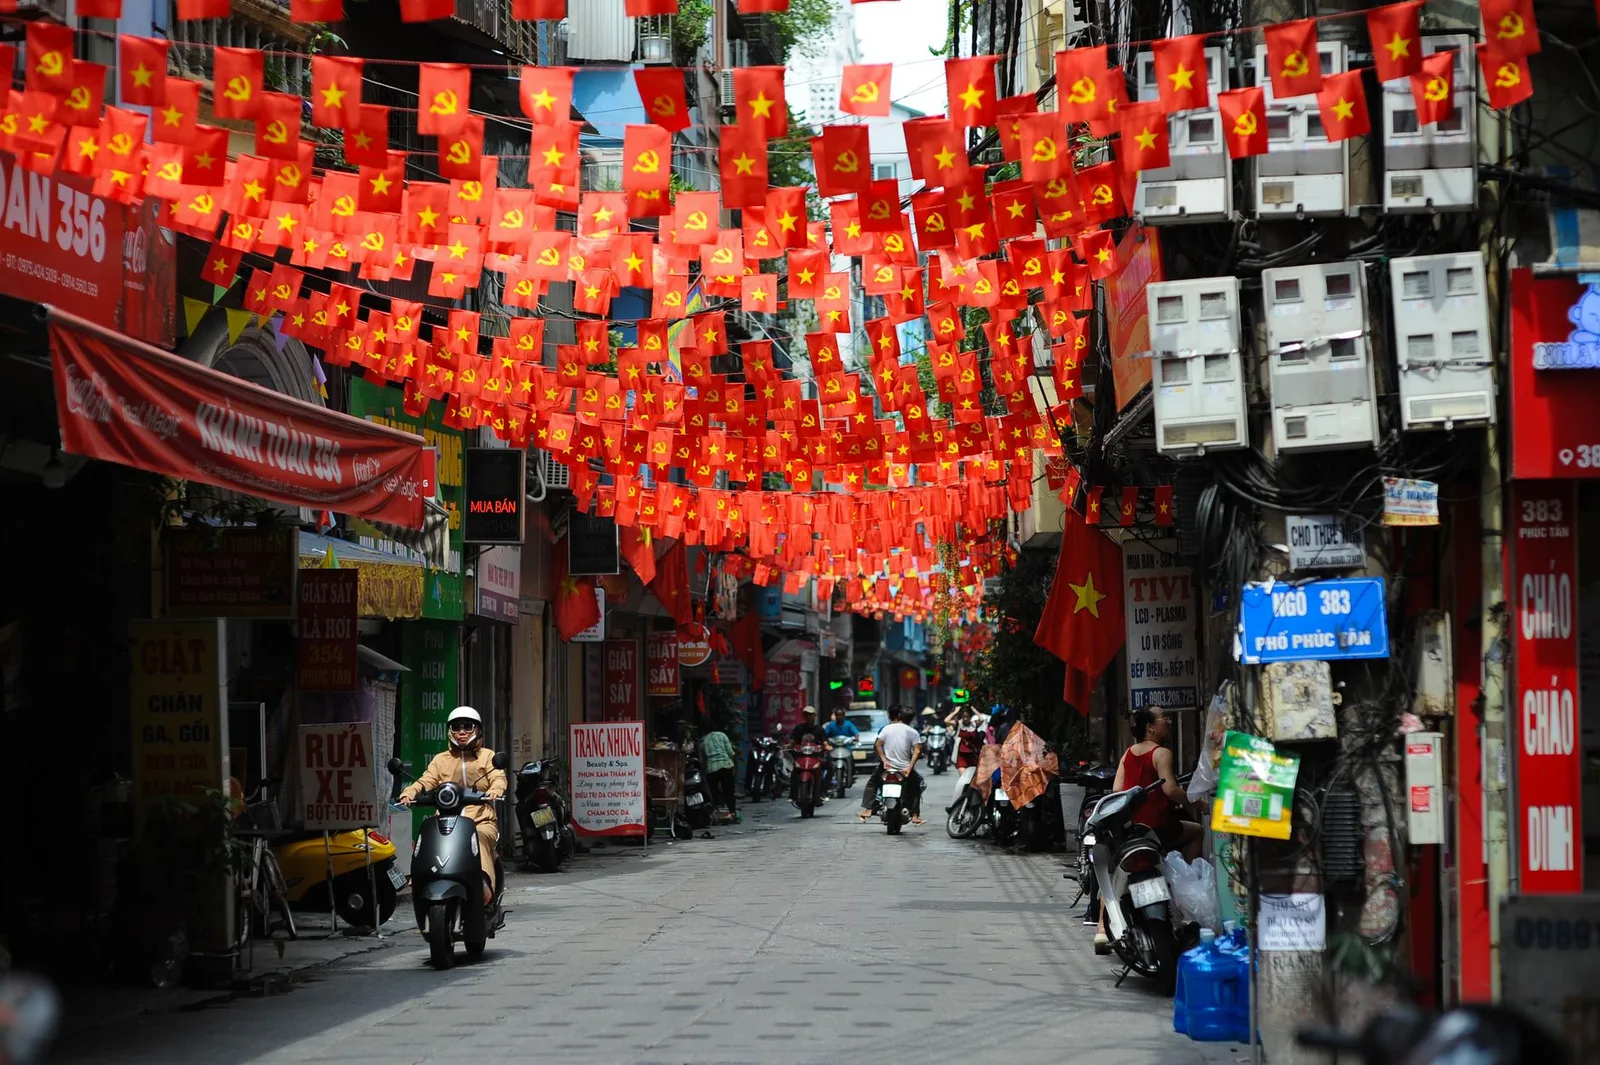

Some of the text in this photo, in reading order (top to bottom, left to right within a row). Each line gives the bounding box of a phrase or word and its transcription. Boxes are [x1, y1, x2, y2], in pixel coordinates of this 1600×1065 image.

[0, 162, 50, 243] AN
[56, 183, 106, 263] 356
[313, 436, 342, 484] 356
[469, 497, 516, 513] MUA BÁN
[1522, 499, 1562, 523] 383
[1291, 525, 1311, 546] CHO
[1129, 574, 1190, 602] TIVI
[1522, 559, 1571, 640] CHÁO
[1134, 605, 1187, 624] LCD PLASMA
[1271, 586, 1351, 618] NGÕ 383
[1141, 631, 1182, 650] LÒ VI SÓNG
[1255, 629, 1288, 652] PHỐ
[1291, 628, 1336, 649] PHÚC
[309, 644, 344, 665] 354
[1131, 656, 1145, 678] BẾP
[1169, 655, 1184, 677] BẾP
[649, 662, 675, 684] SẤY
[148, 691, 203, 713] CHĂN
[609, 675, 632, 704] SẤY
[1523, 675, 1574, 756] CHÁO
[142, 717, 212, 744] GA, GỐI
[574, 726, 640, 758] TRANG NHUNG
[305, 724, 367, 768] RỬA
[615, 760, 628, 768] Spa
[315, 770, 353, 804] XE
